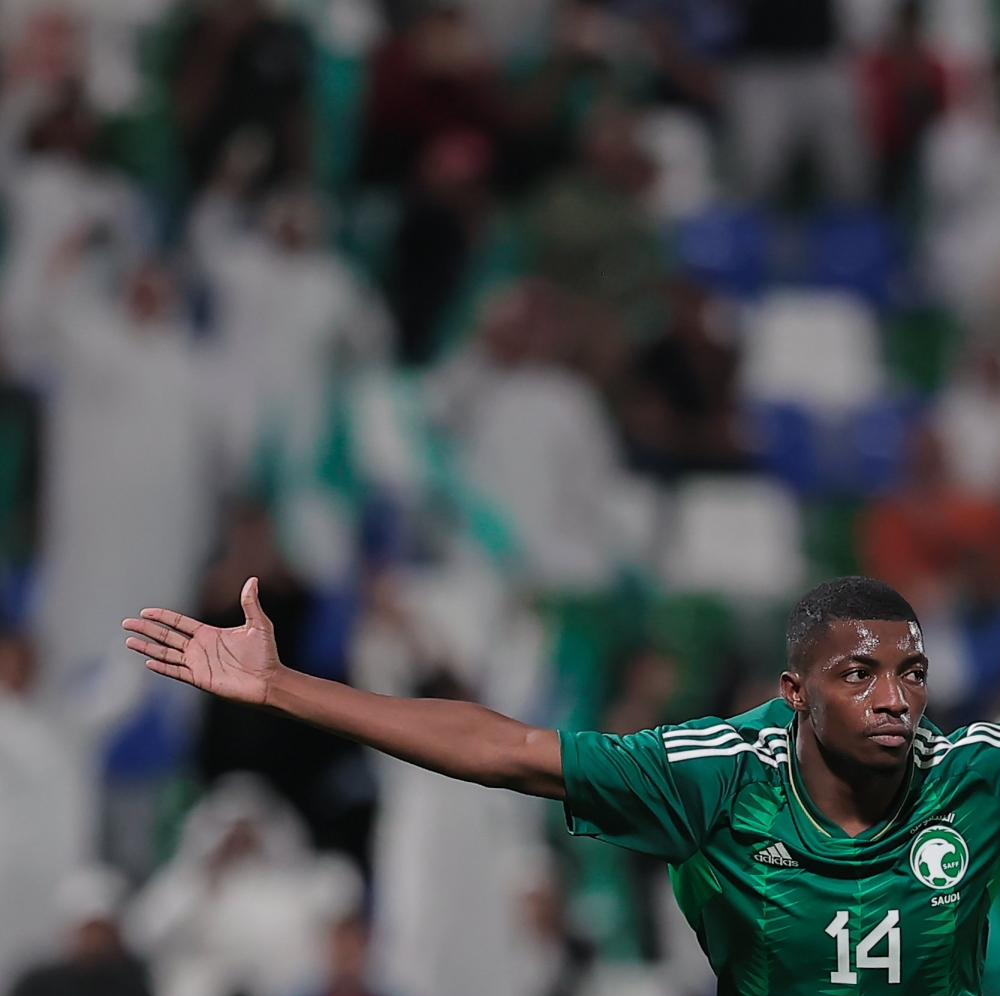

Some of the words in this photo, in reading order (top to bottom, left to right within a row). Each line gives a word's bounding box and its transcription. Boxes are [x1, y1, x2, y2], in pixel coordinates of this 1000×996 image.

[754, 854, 799, 867] adidas
[942, 861, 959, 870] SAFF
[931, 892, 960, 907] SAUDI
[825, 910, 901, 984] 14
